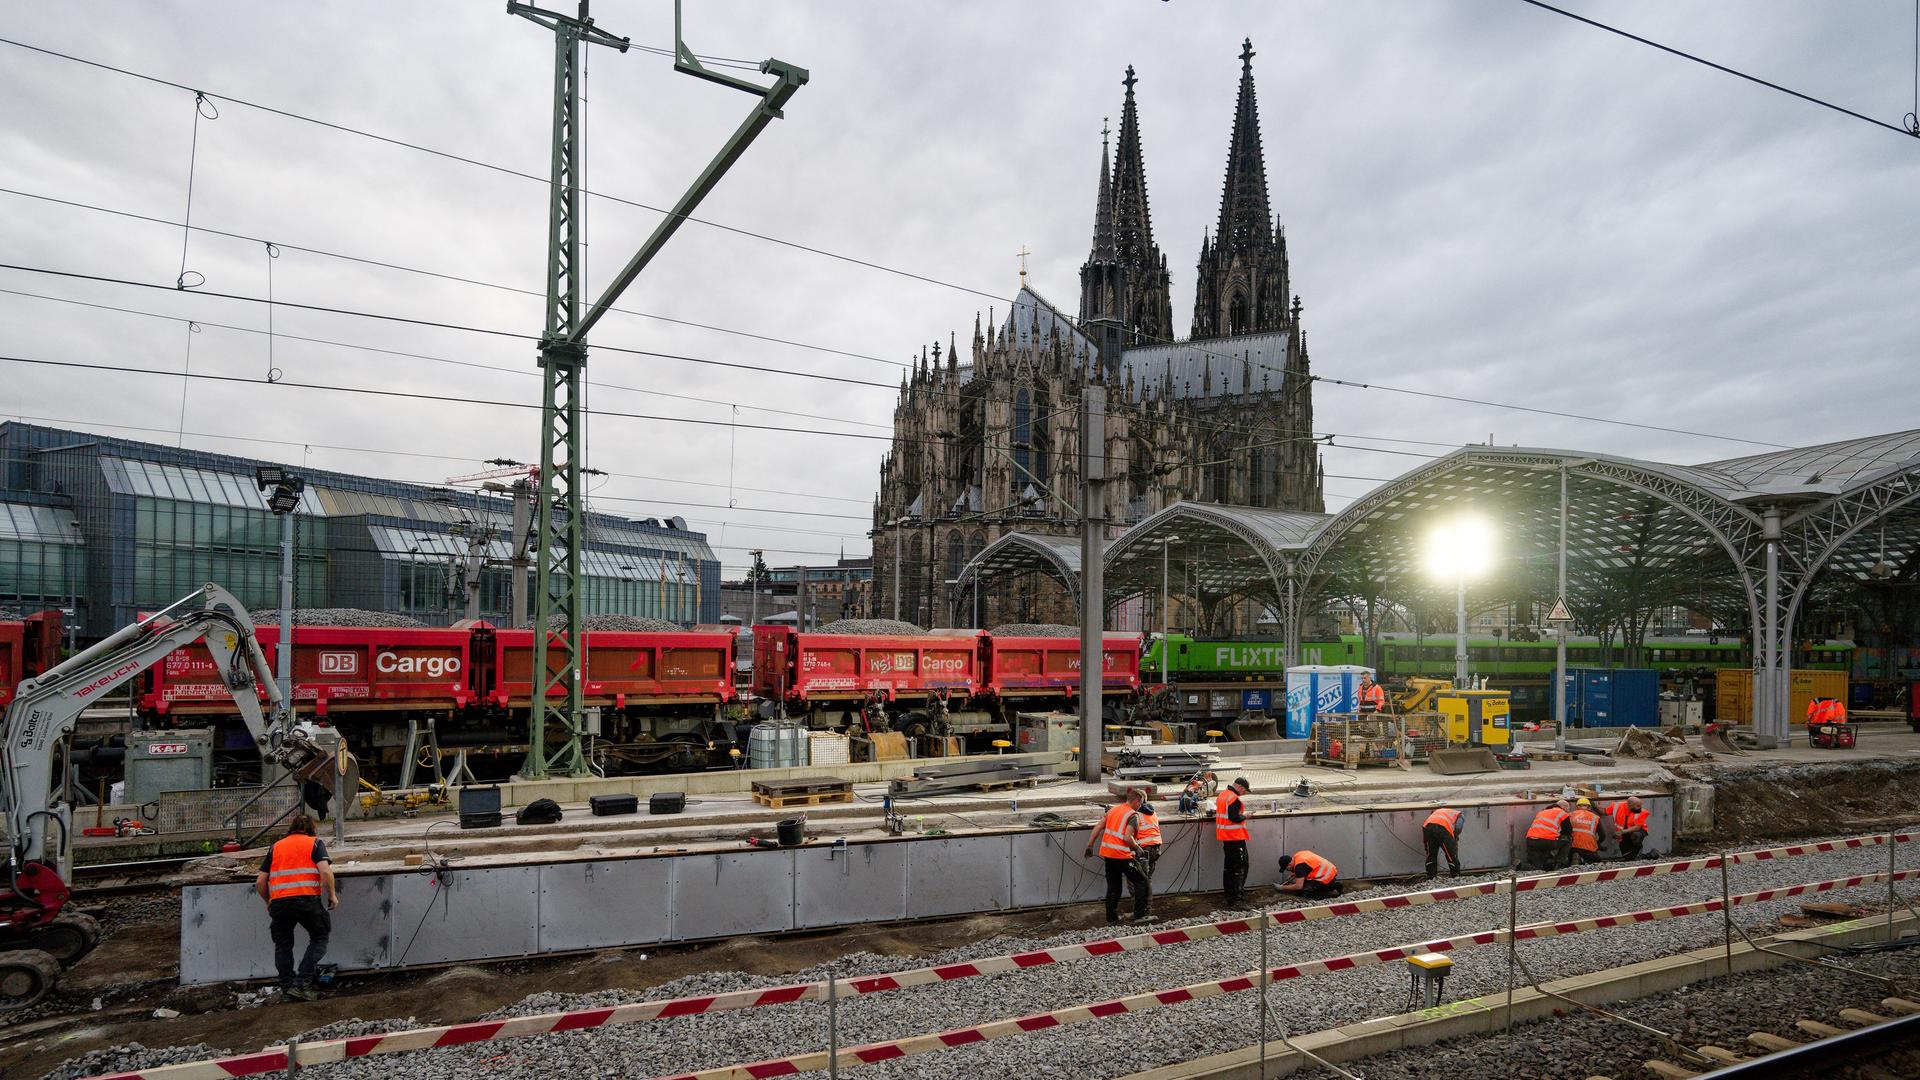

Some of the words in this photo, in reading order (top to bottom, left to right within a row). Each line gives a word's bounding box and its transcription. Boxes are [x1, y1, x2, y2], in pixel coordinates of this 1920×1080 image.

[323, 653, 355, 672] DB
[376, 652, 461, 677] Cargo
[922, 656, 963, 671] Cargo
[1216, 648, 1321, 666] FLiXTRIN
[73, 661, 140, 697] TAKEUCHI
[23, 710, 41, 737] Balter
